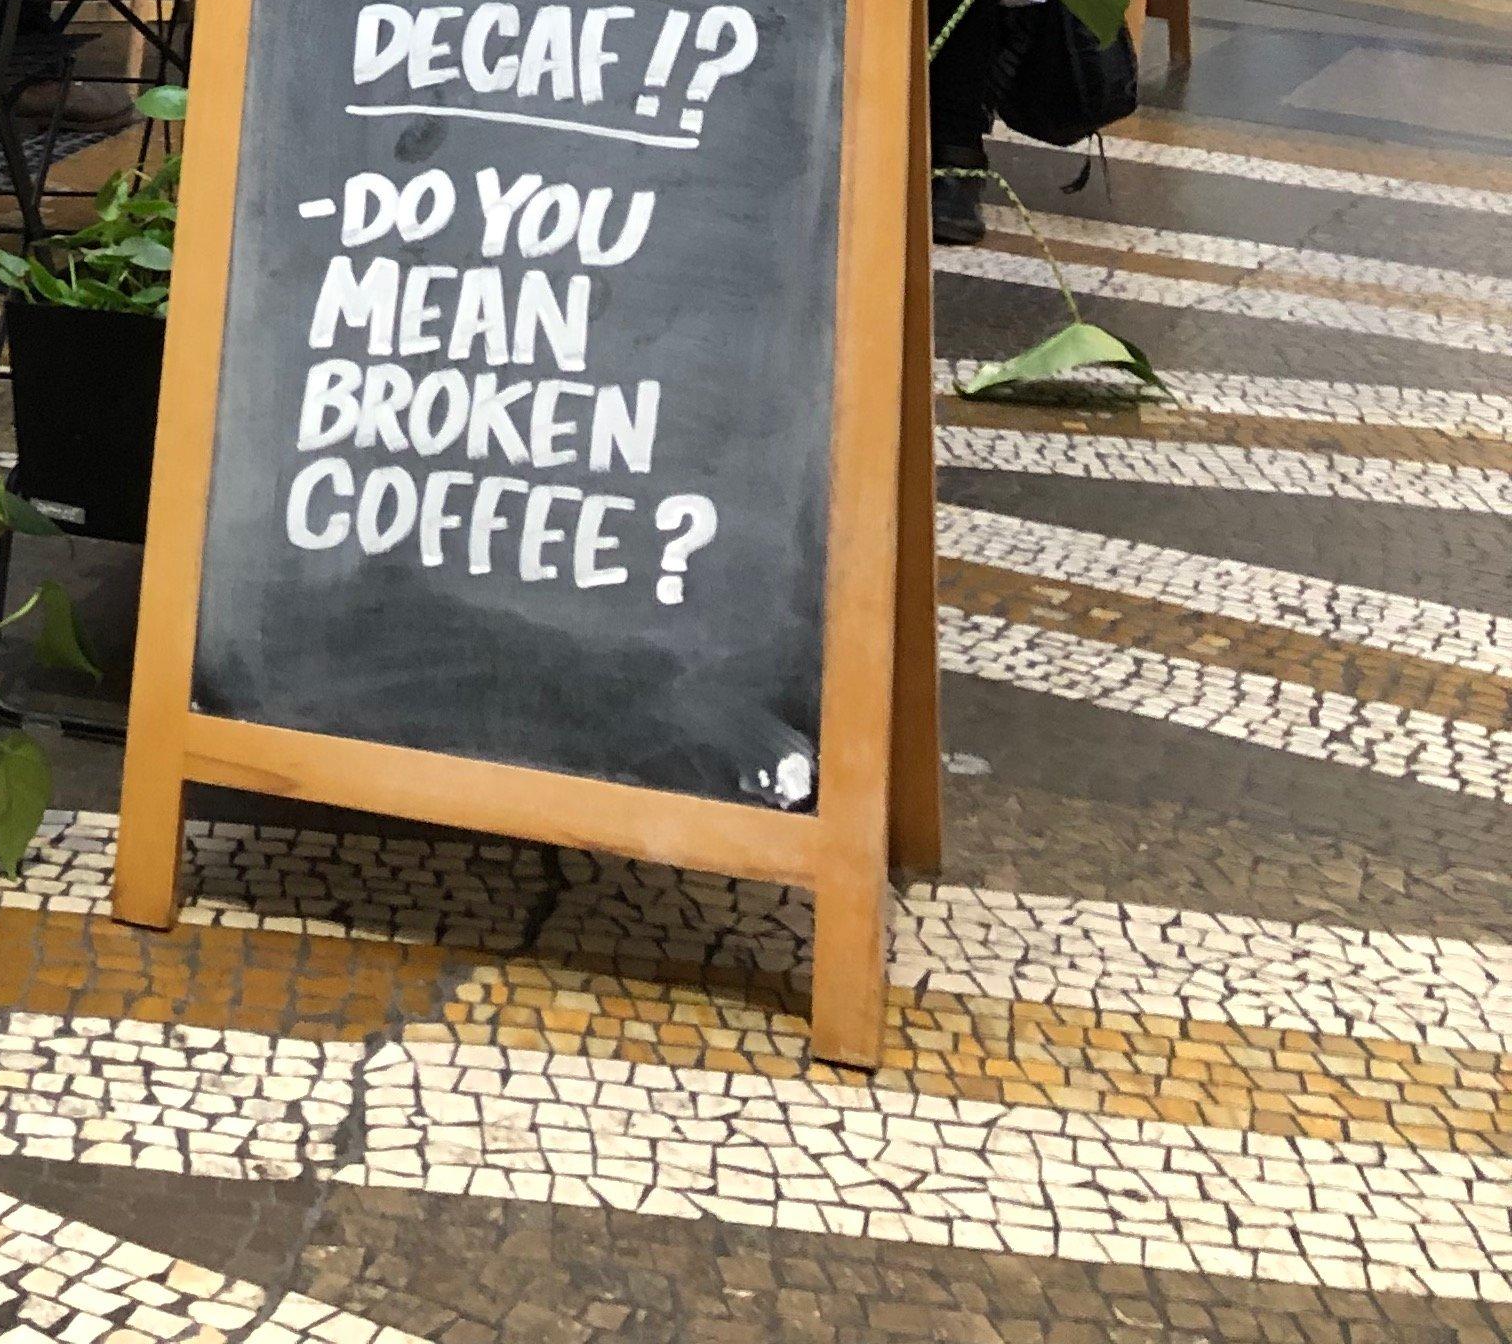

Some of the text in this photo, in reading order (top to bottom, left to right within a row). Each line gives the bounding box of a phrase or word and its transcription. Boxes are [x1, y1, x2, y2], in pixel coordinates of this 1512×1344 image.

[353, 2, 635, 105] DECAF
[475, 166, 656, 266] YOU
[308, 255, 591, 372] MEAN
[297, 358, 661, 474] BROKEN
[286, 457, 718, 606] COFFEE ?
